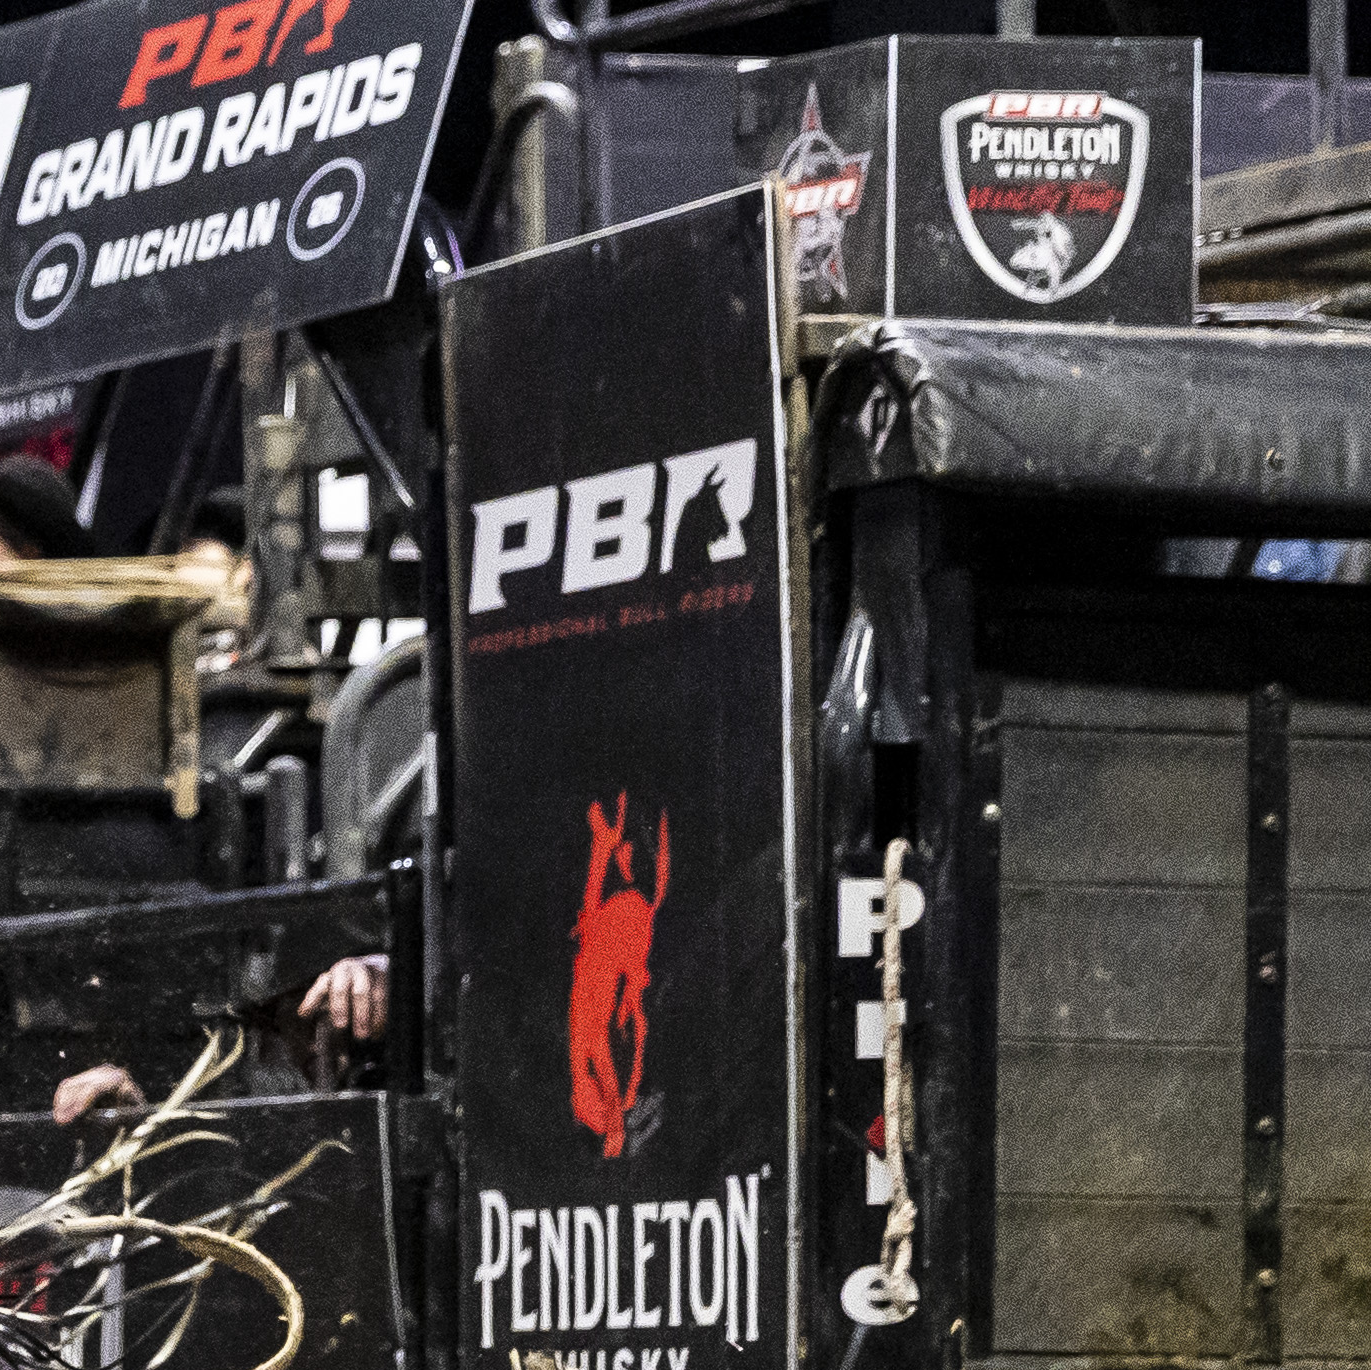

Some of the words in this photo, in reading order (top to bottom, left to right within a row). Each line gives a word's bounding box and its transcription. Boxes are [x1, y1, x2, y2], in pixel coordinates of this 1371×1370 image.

[17, 106, 206, 226] GRAND
[203, 42, 423, 174] RAPIDS
[969, 121, 1122, 164] PENDLETON
[994, 160, 1098, 180] WHISKY
[90, 197, 281, 288] MICHIGAN
[473, 1172, 761, 1350] PENDLETON
